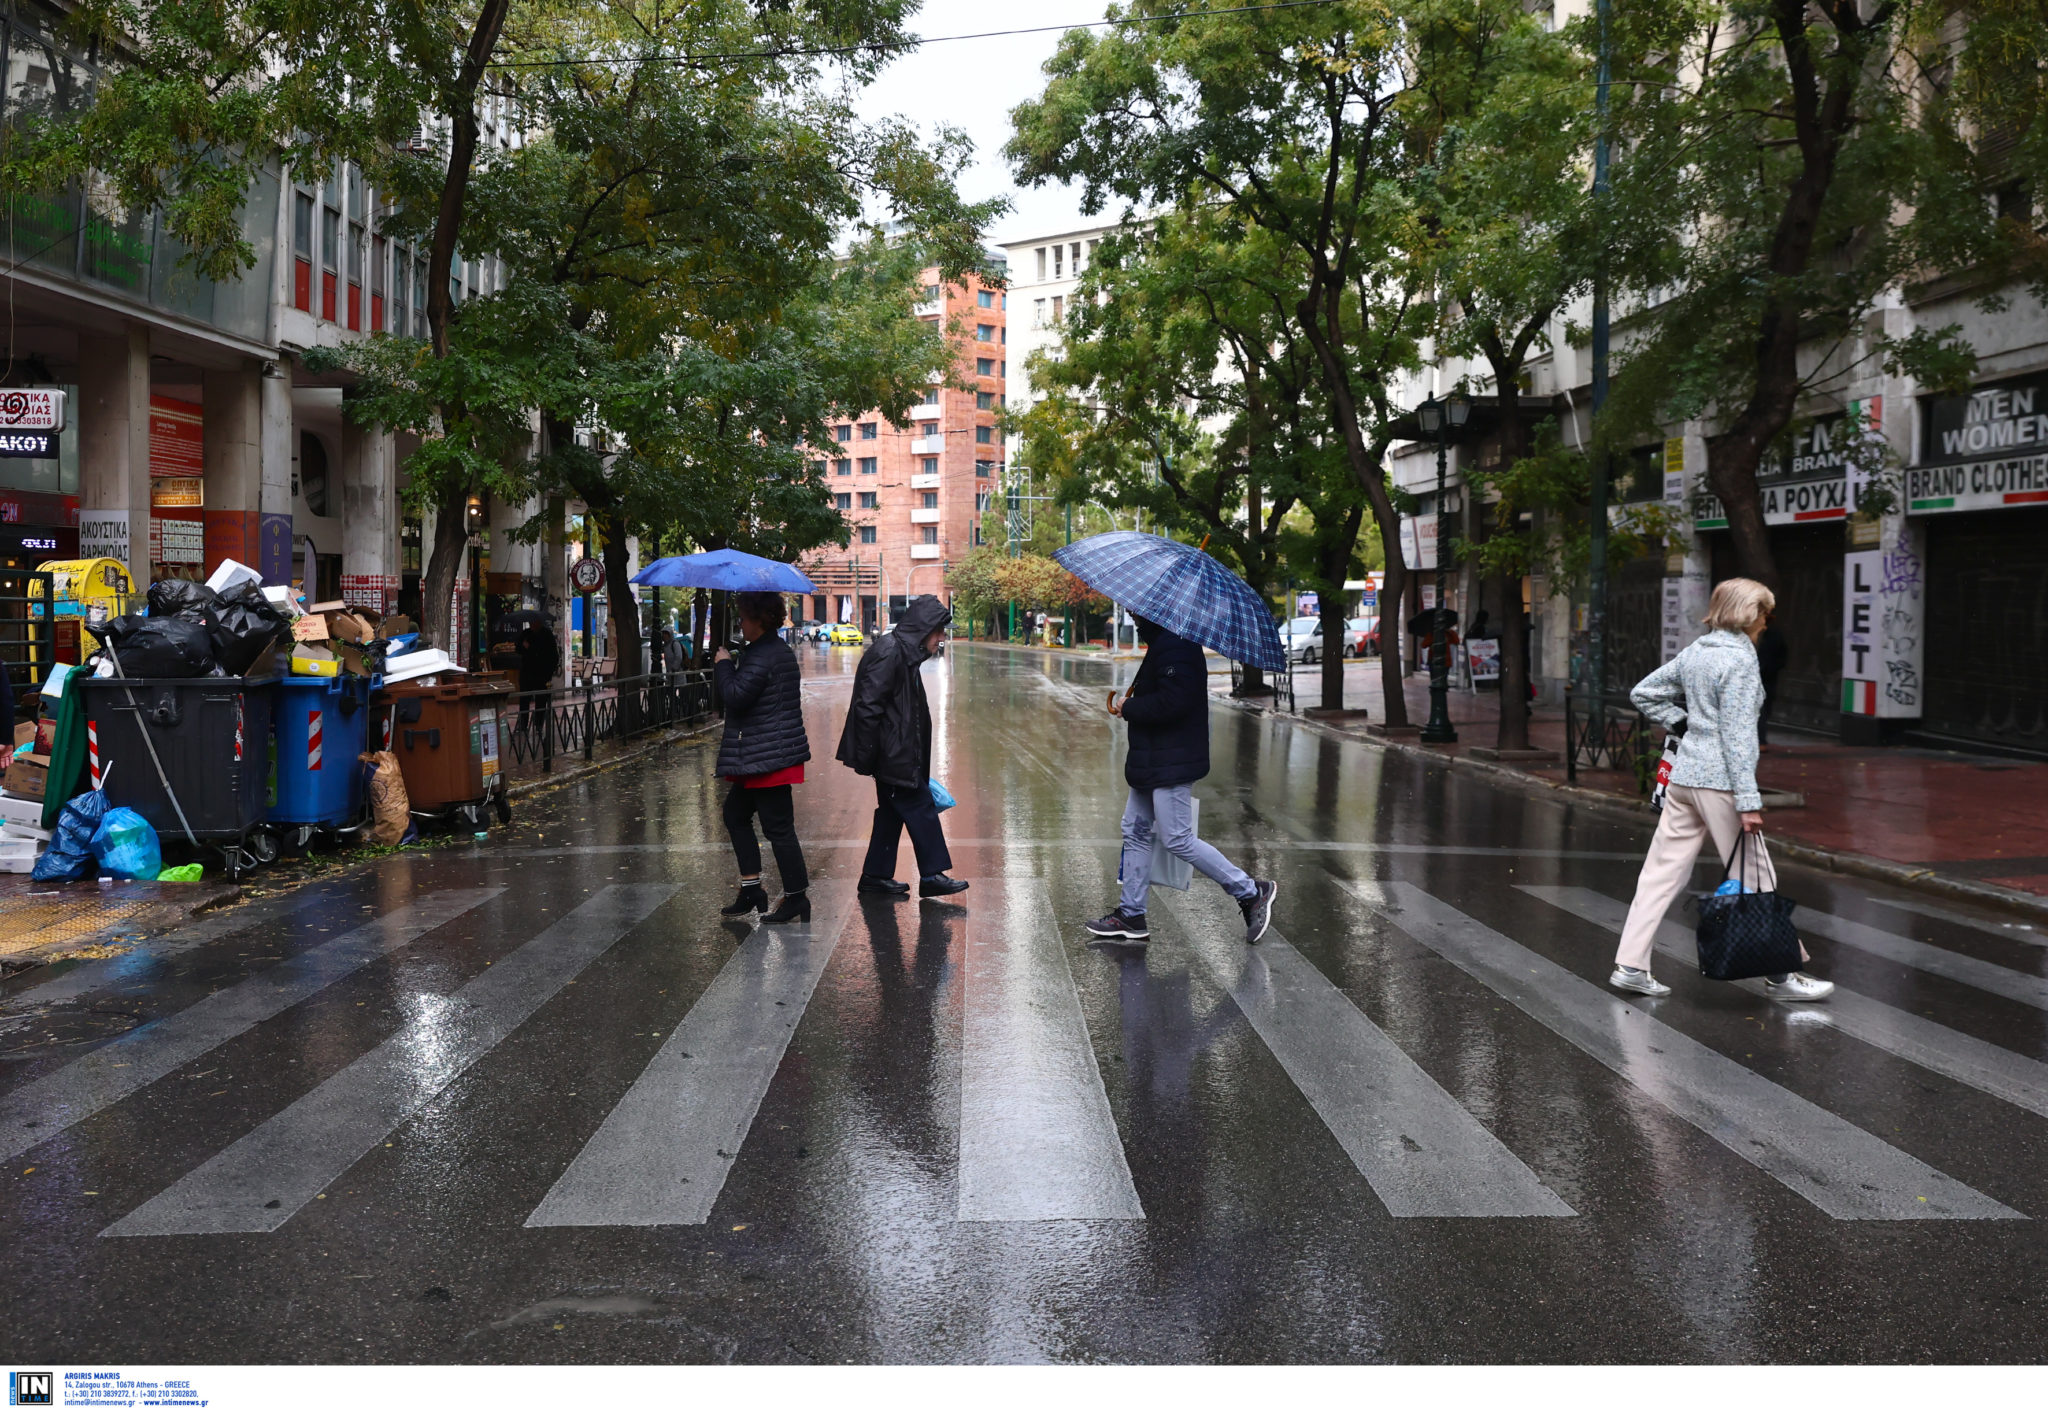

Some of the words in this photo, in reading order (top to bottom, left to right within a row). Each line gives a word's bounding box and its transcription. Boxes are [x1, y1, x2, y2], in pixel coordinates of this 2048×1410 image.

[1967, 387, 2036, 424] MEN
[1911, 467, 1966, 498] BRAND
[1971, 457, 2048, 494] CLOTHE
[80, 521, 128, 539] ΑΚΟΥΣΤΙΚΑ
